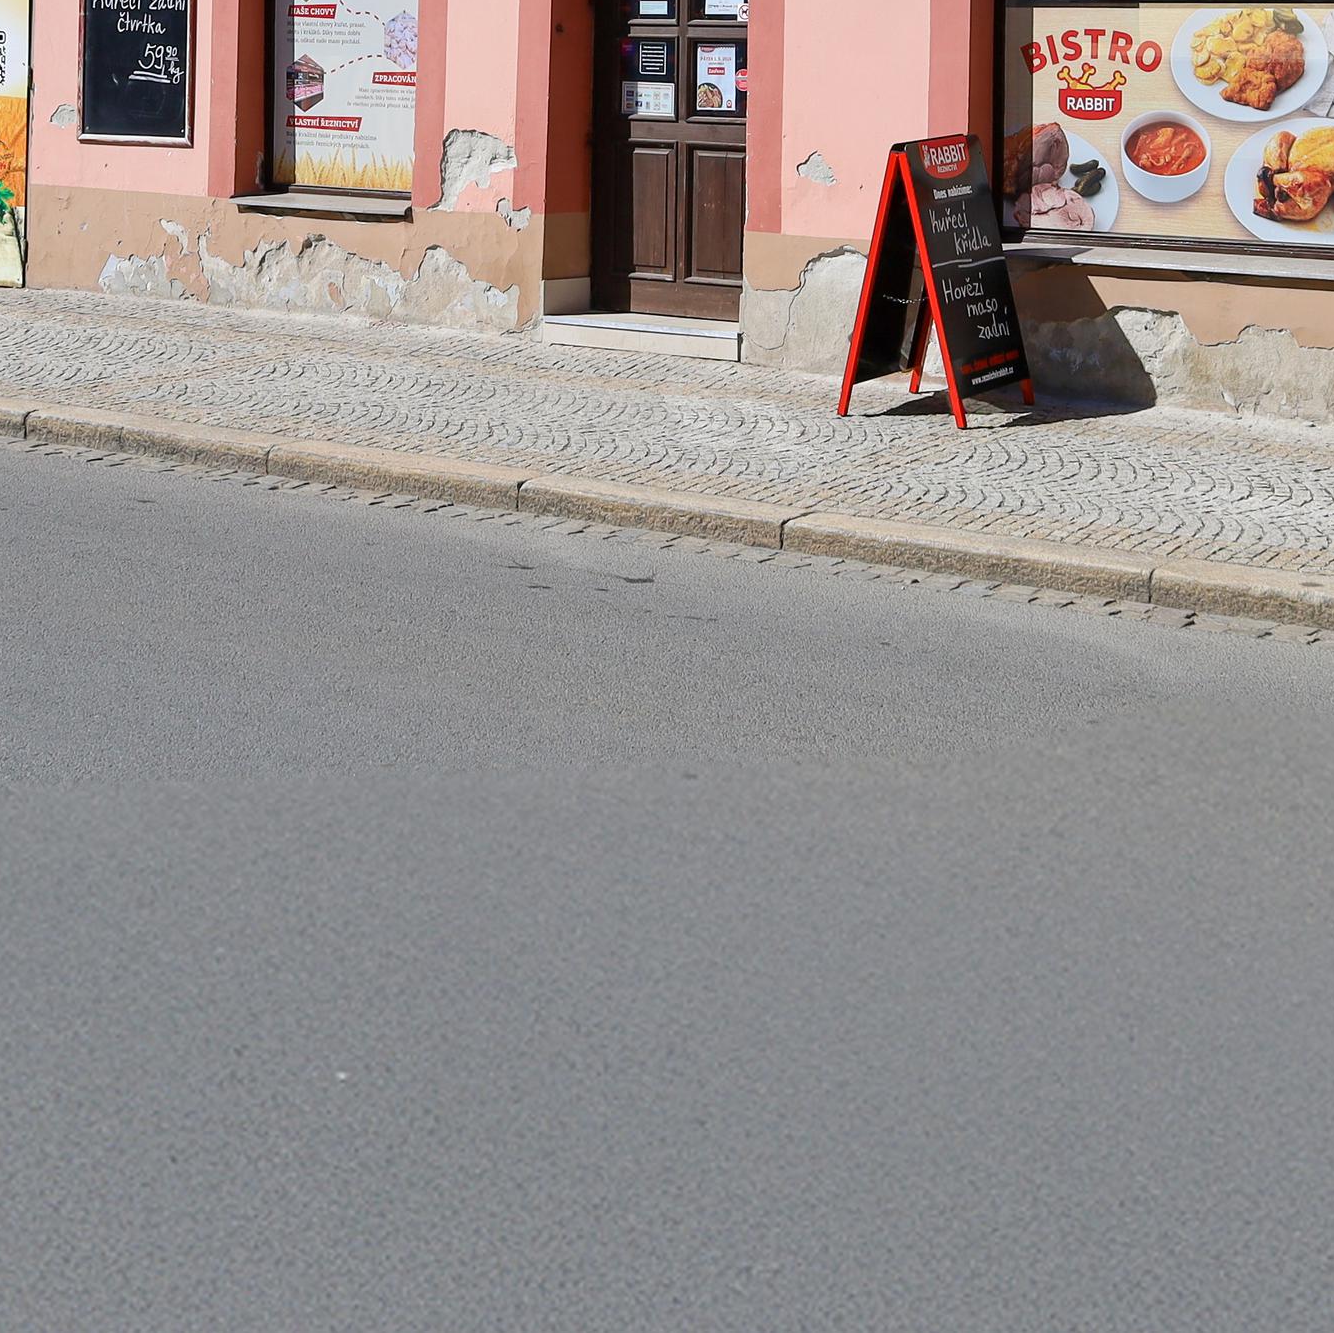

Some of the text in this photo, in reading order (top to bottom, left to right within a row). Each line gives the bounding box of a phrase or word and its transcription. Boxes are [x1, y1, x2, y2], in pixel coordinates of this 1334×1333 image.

[310, 7, 335, 16] CHOVY
[1020, 28, 1163, 76] BISTRO
[1066, 96, 1115, 113] RABBIT
[929, 143, 966, 166] RABBIT
[942, 271, 985, 304] Hovězí
[967, 298, 998, 318] maso
[977, 306, 1010, 340] zadní
